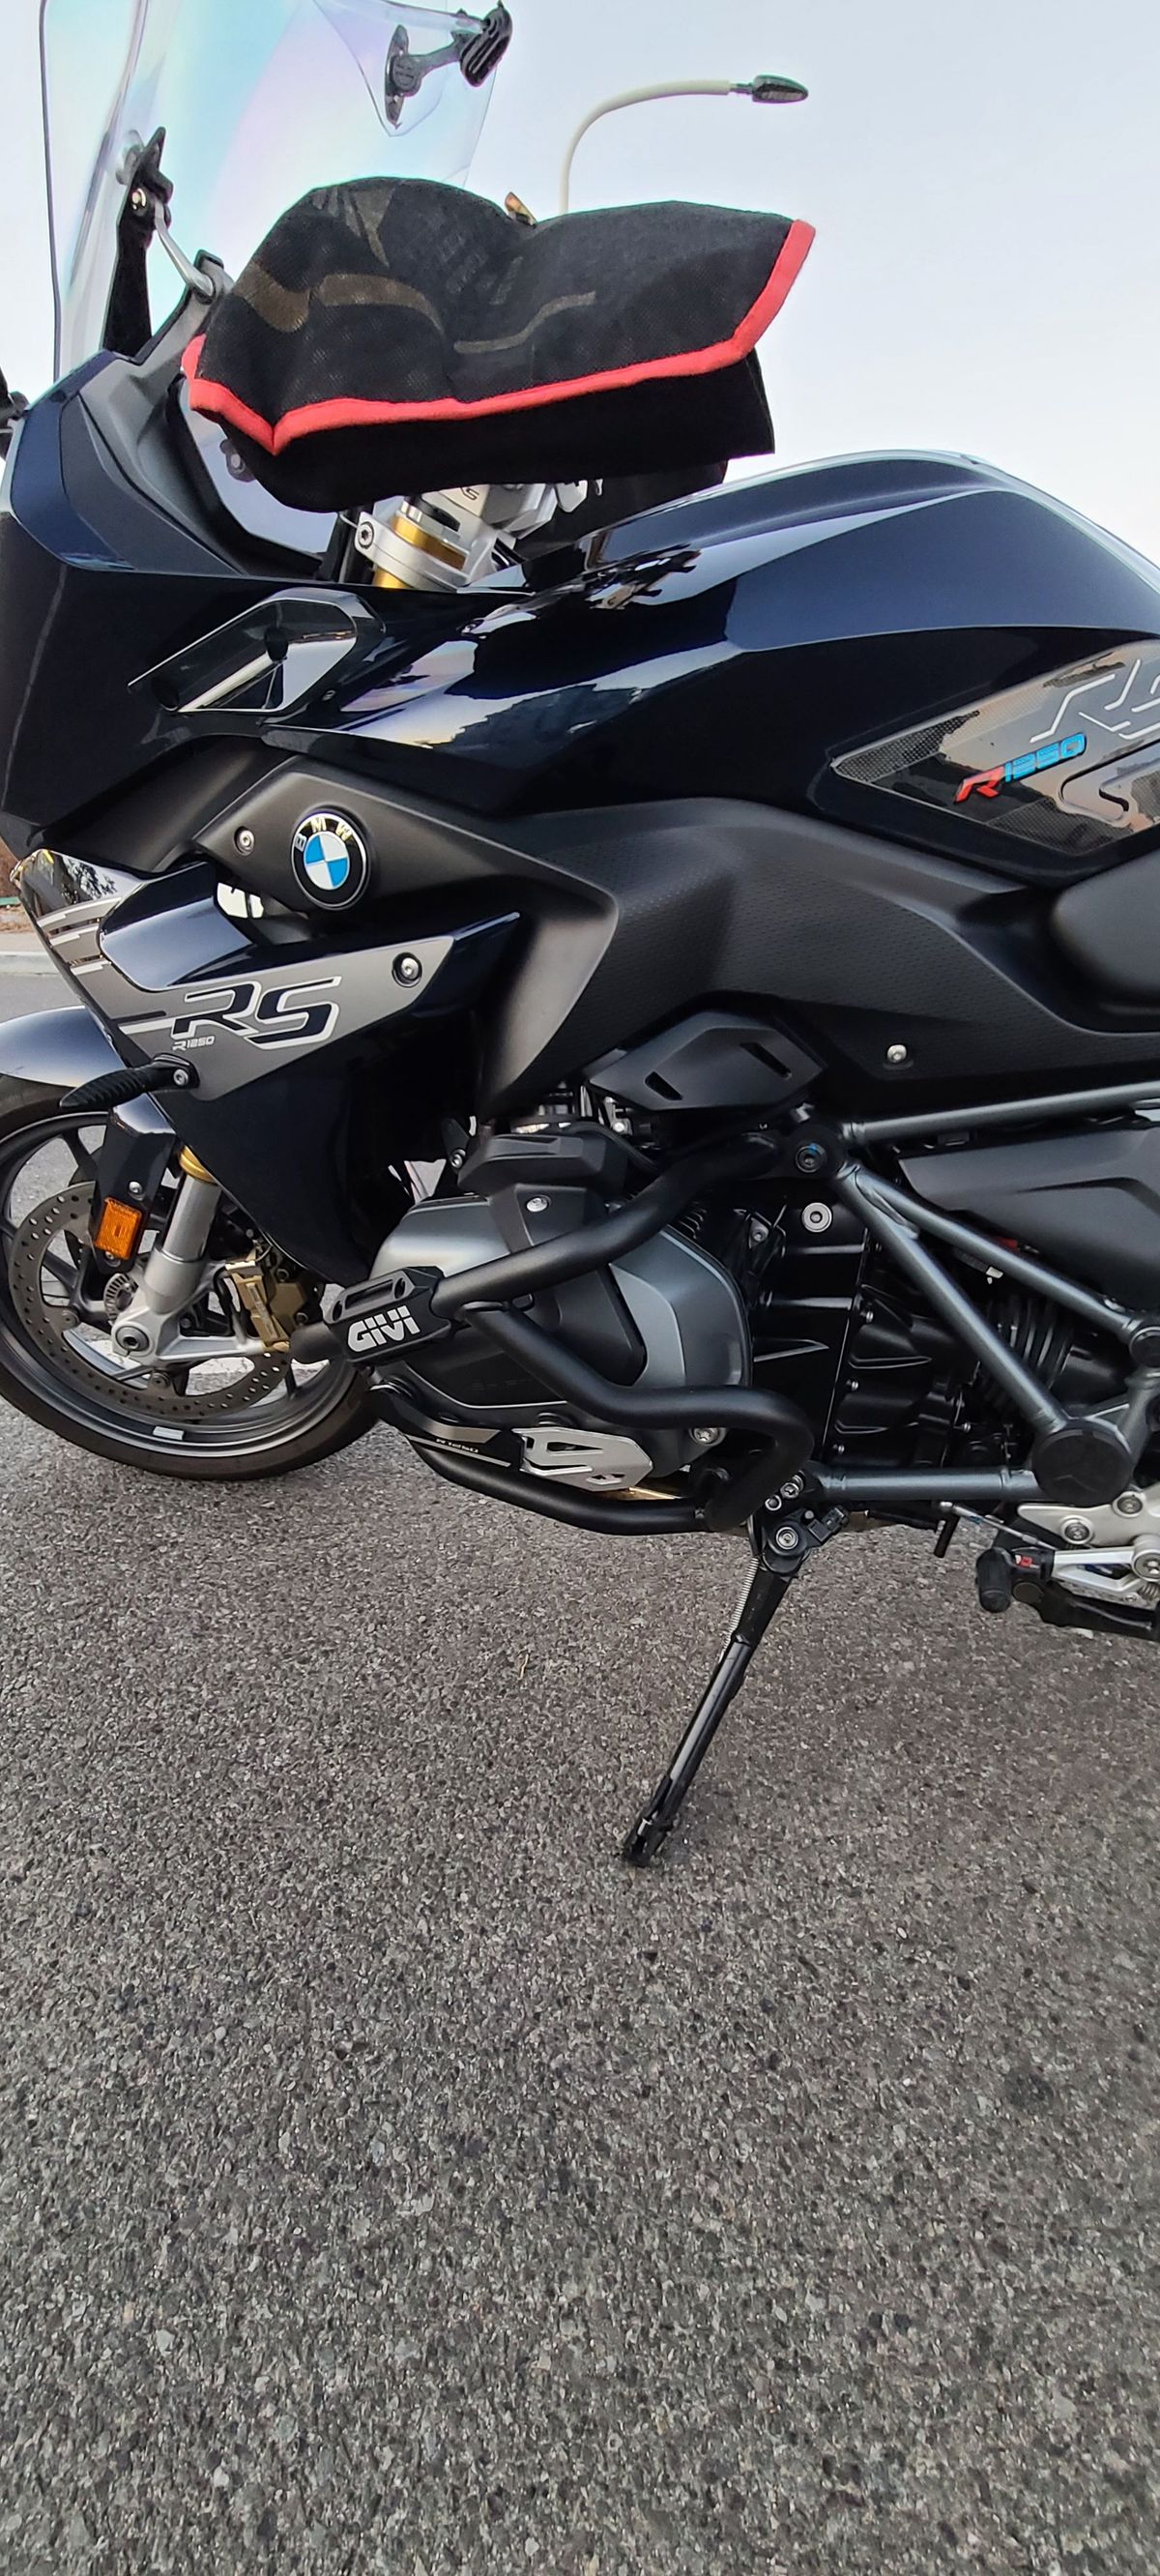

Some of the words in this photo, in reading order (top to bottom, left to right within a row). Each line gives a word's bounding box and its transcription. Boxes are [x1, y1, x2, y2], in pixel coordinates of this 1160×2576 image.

[955, 732, 1087, 804] R1250
[295, 816, 353, 852] BMW
[171, 976, 341, 1050] RS
[172, 1036, 215, 1051] R1250
[348, 1305, 420, 1352] GIVI
